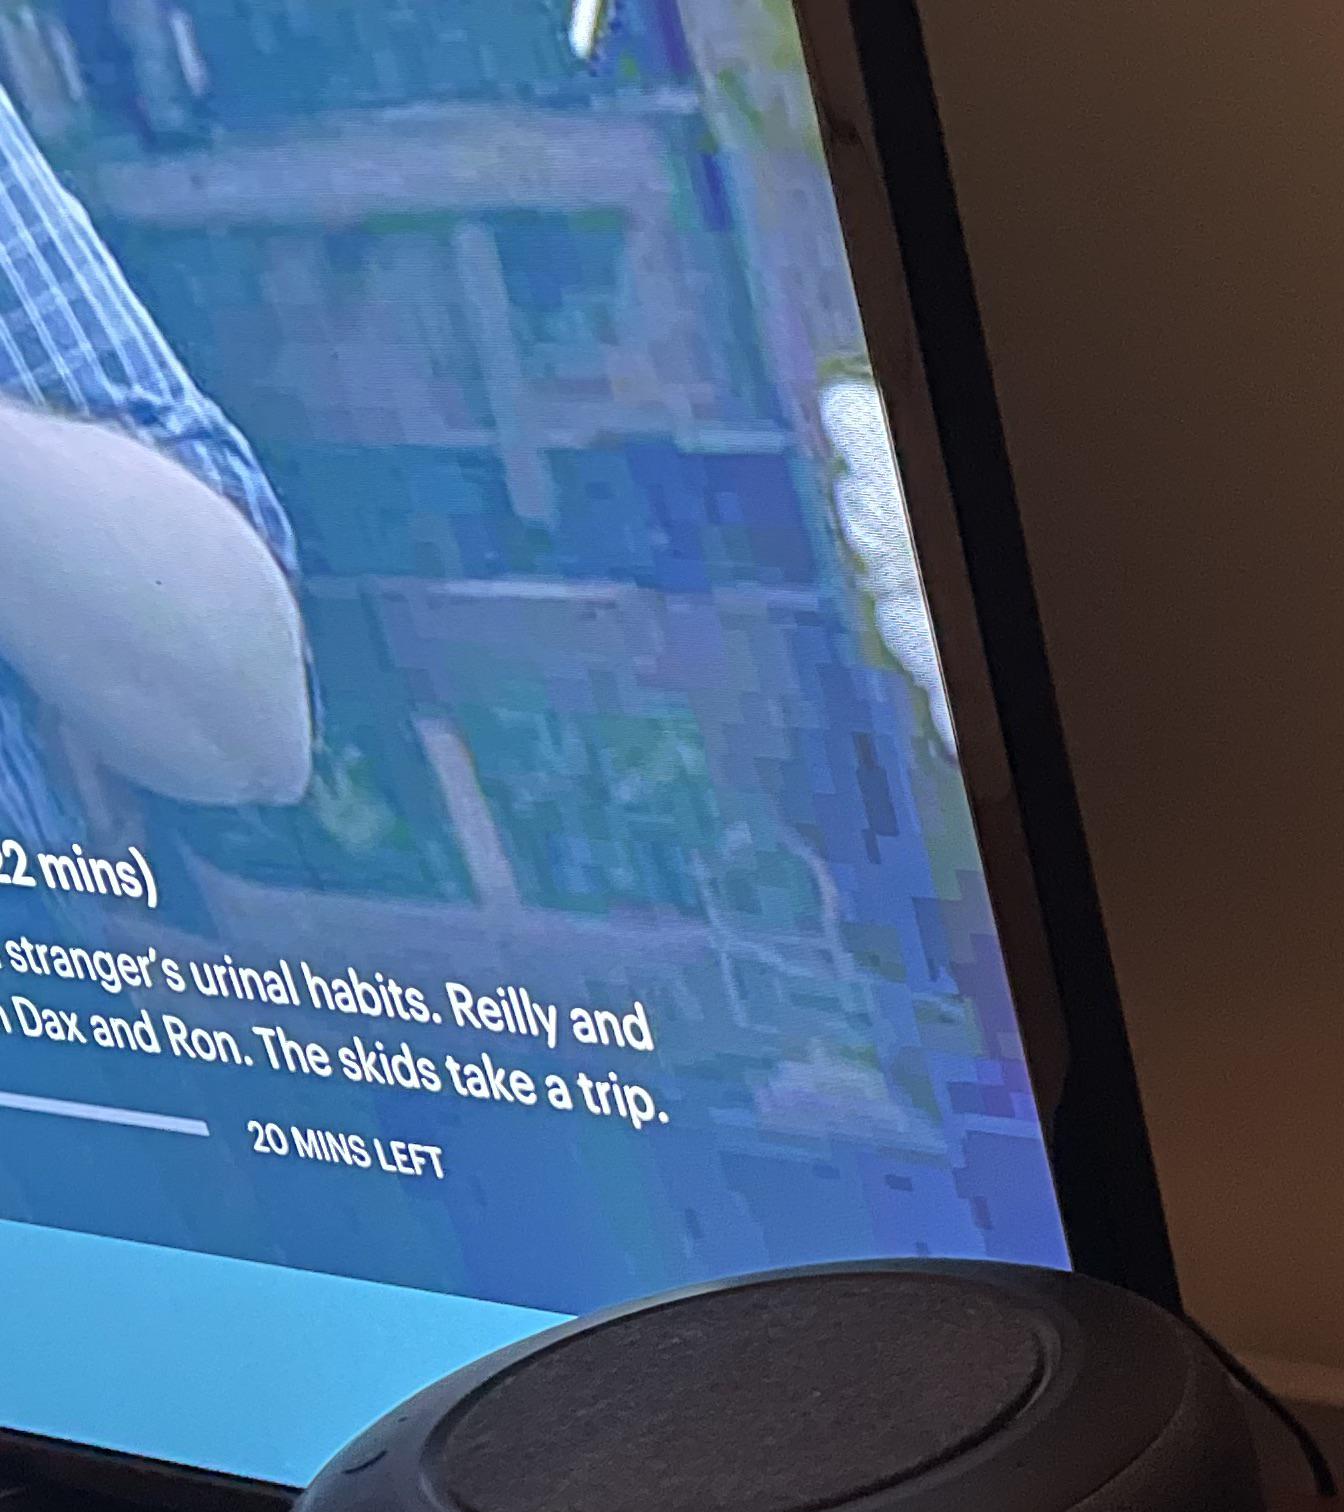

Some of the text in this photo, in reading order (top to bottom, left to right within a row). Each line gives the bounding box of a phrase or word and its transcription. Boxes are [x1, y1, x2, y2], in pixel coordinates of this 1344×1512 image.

[37, 843, 158, 908] mins)
[189, 954, 300, 1006] urinal
[300, 961, 442, 1024] habits.
[445, 982, 557, 1049] Reilly
[570, 1001, 654, 1051] and
[11, 996, 87, 1044] Dax
[90, 1009, 161, 1053] and
[162, 1014, 253, 1066] Ron.
[252, 1026, 333, 1077] The
[338, 1036, 442, 1092] skids
[445, 1052, 538, 1105] take
[545, 1074, 573, 1110] a
[576, 1071, 669, 1130] trip.
[247, 1120, 444, 1179] 20 MINS LEFT
